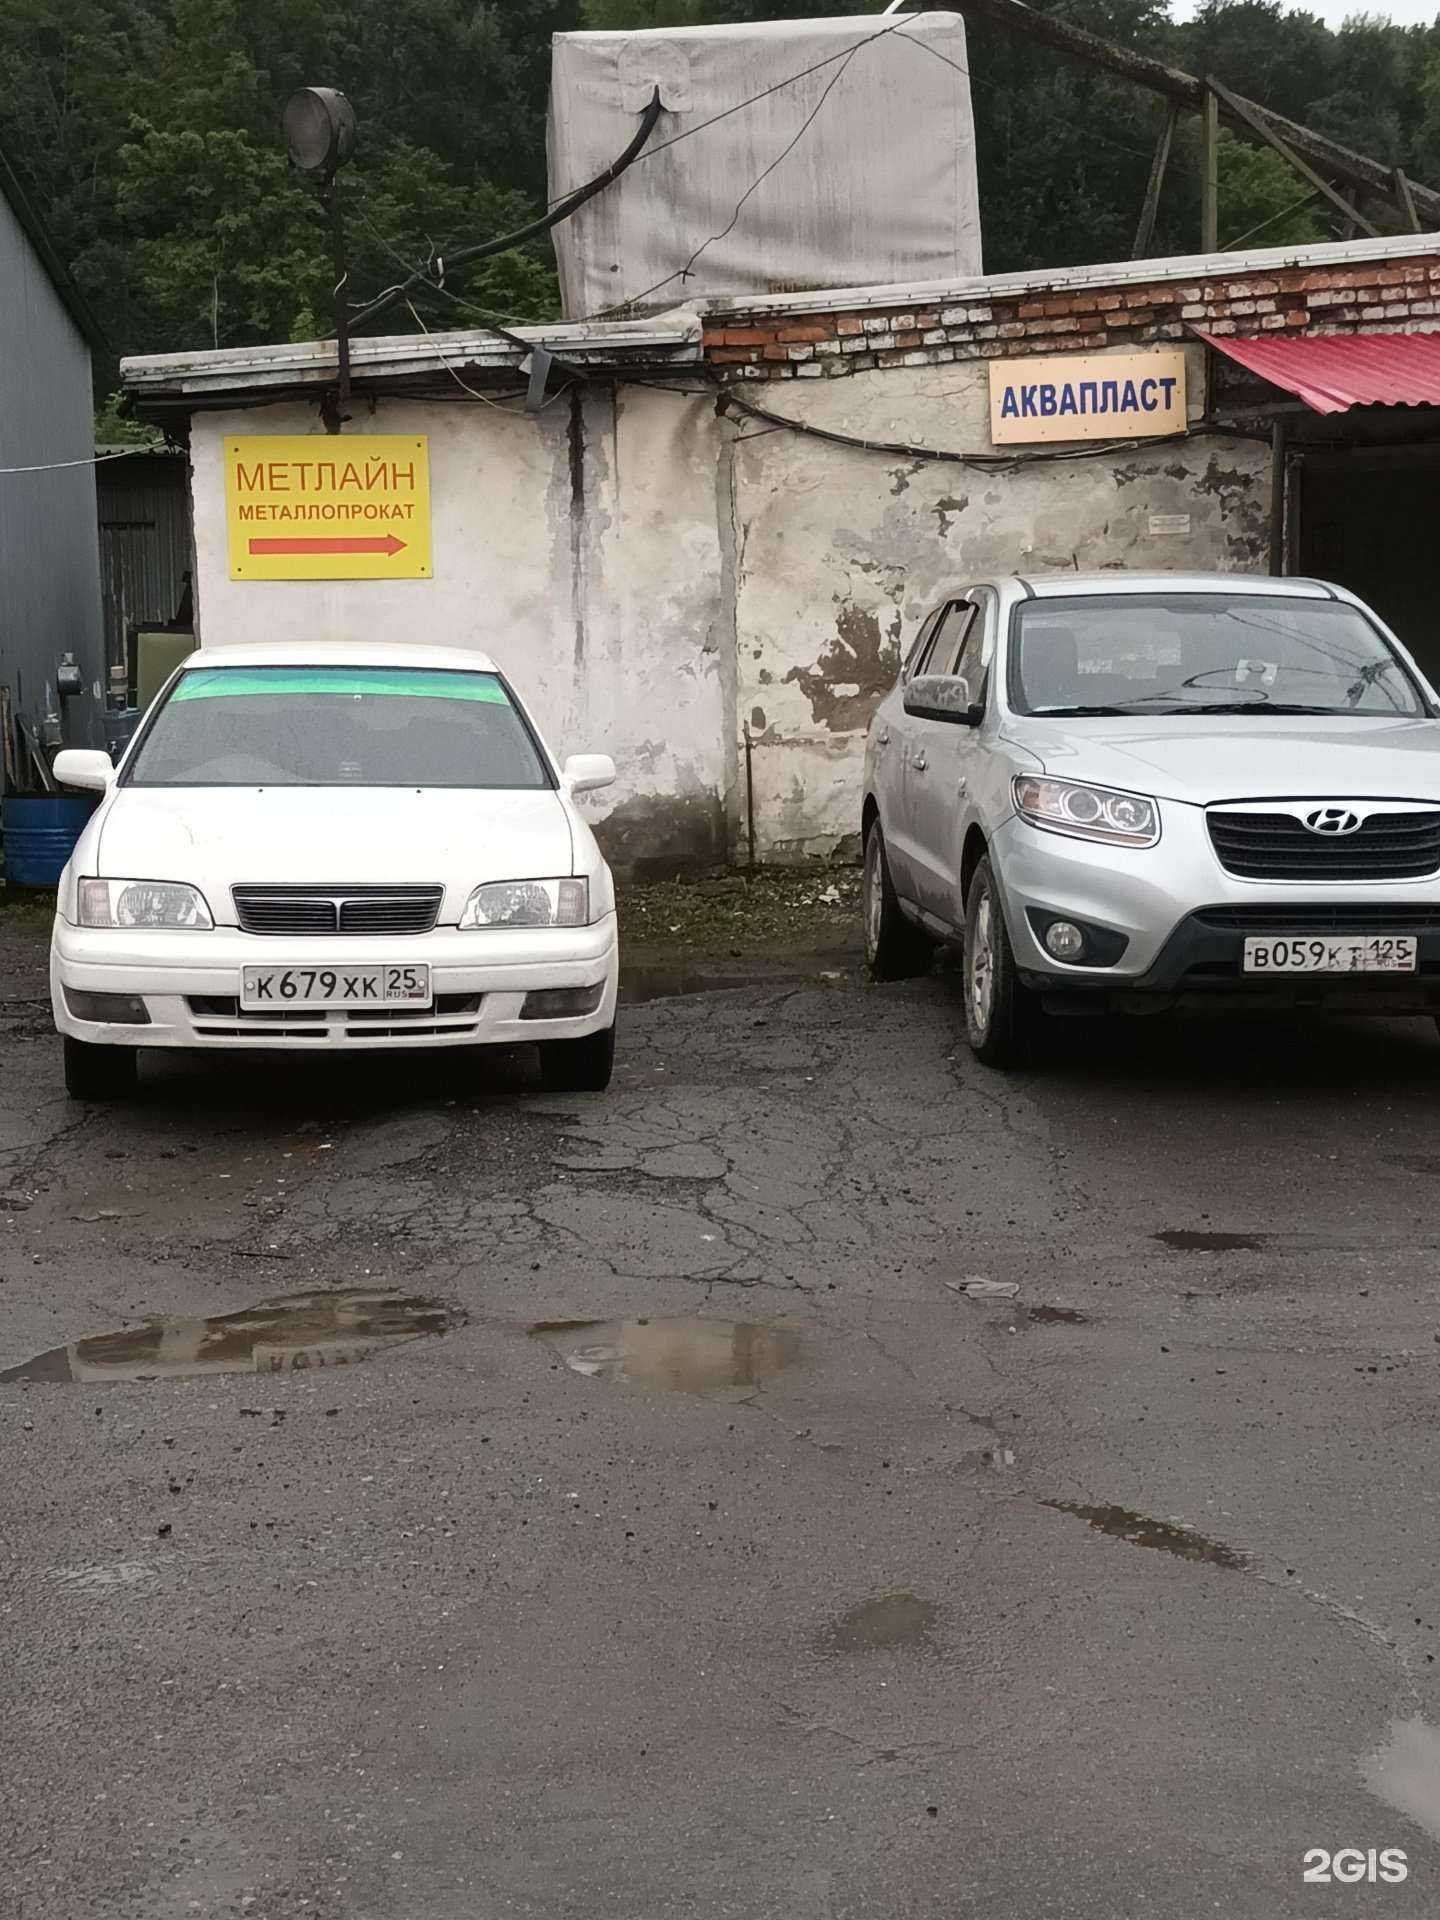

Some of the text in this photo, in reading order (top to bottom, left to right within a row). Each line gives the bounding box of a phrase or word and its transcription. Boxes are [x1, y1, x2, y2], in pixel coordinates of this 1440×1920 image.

[1000, 377, 1177, 419] АКВАПЛАСТ
[236, 455, 415, 492] МЕТЛАЙН
[238, 503, 415, 521] МЕТАЛЛОПРОКАТ
[388, 968, 417, 990] 25
[386, 990, 408, 998] RUS
